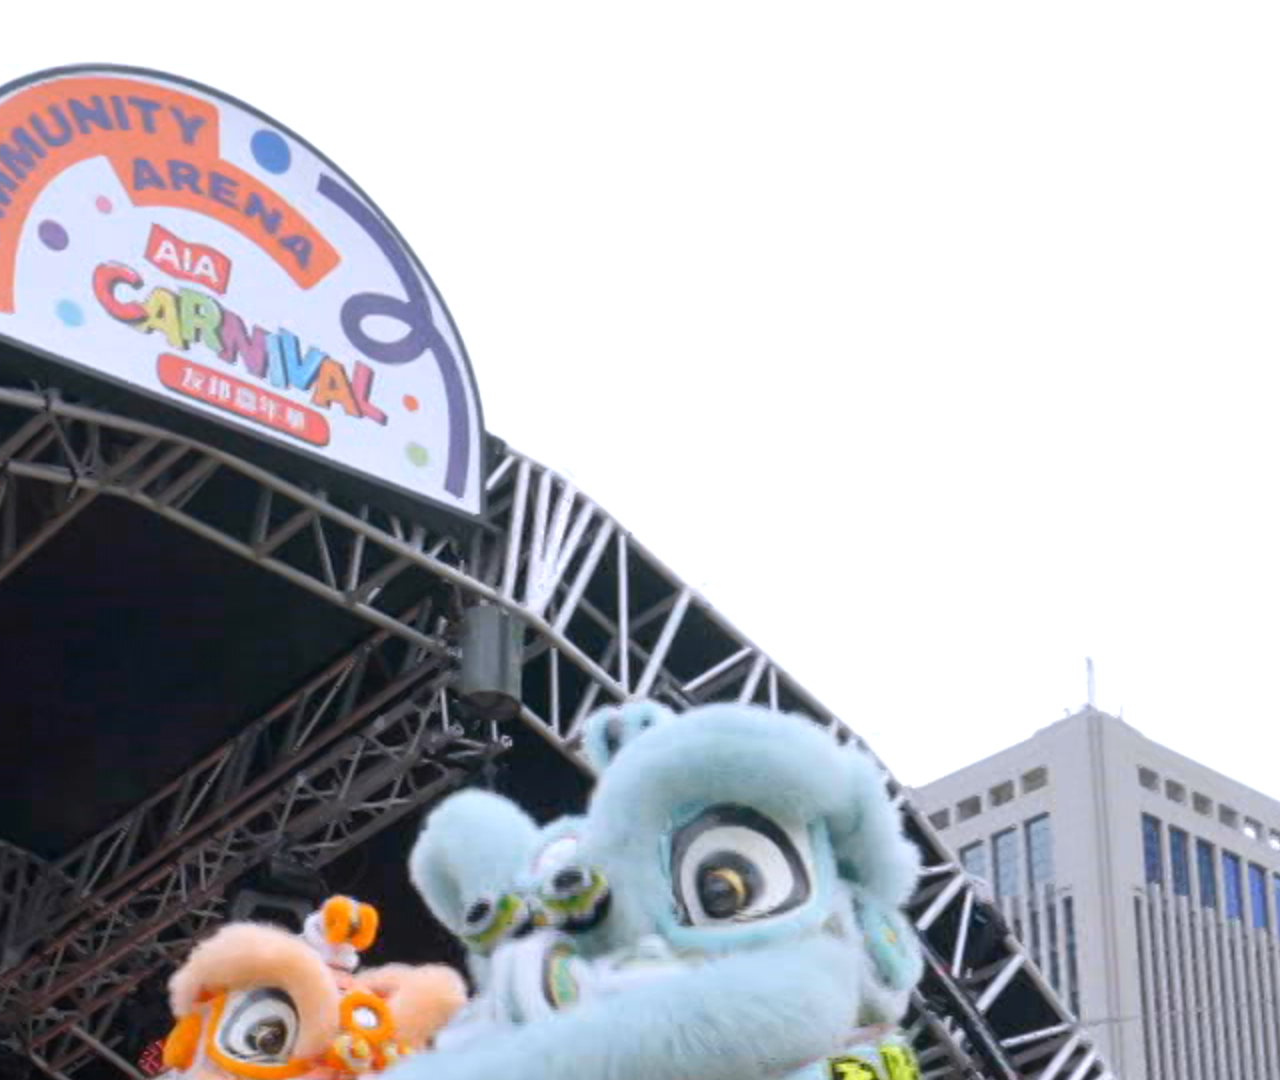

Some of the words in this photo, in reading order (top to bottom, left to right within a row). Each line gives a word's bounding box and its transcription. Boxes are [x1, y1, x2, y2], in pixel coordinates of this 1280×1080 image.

[132, 157, 318, 271] ARENA
[153, 239, 221, 284] AIA
[92, 262, 388, 426] CARNIVAL
